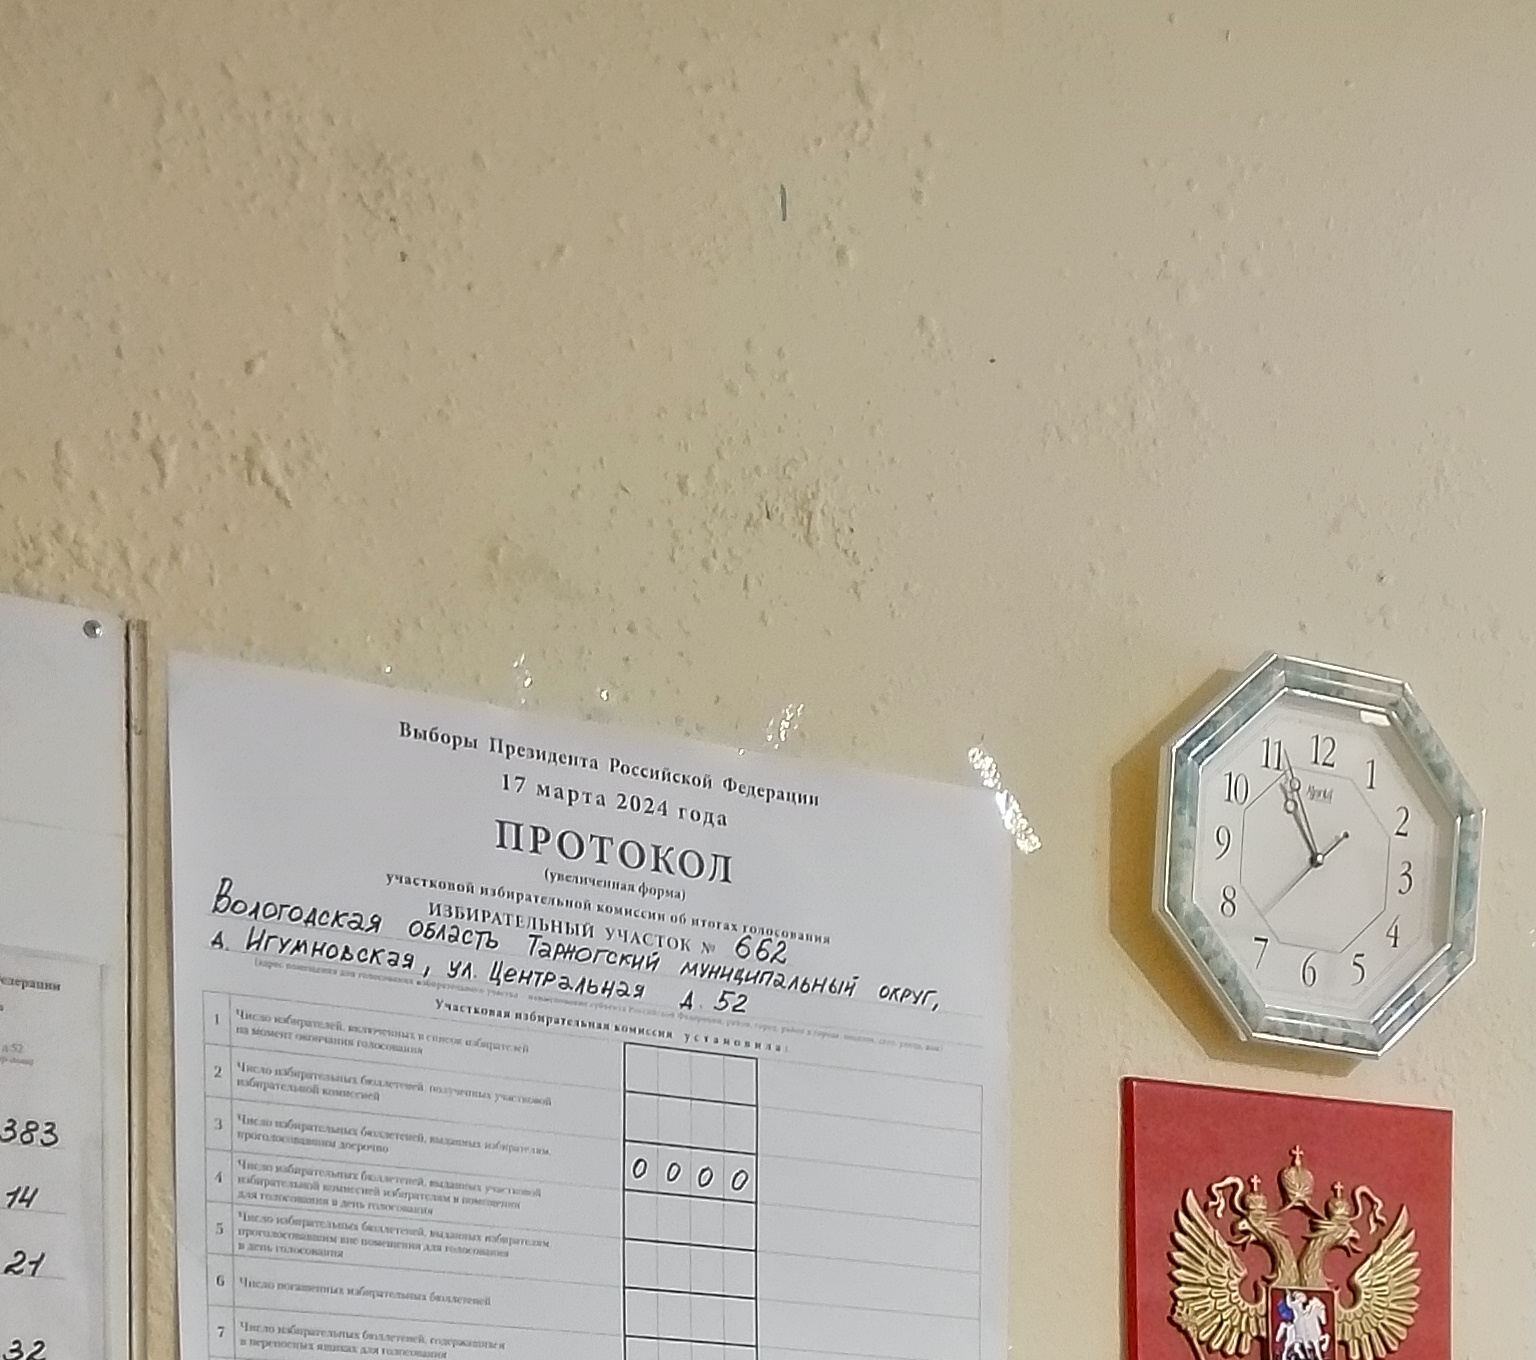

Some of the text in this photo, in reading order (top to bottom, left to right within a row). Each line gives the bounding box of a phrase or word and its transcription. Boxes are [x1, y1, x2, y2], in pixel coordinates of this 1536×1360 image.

[400, 721, 820, 807] Выборы Президента Российской Федерации
[1260, 736, 1285, 772] 11
[1310, 733, 1337, 769] 12
[1224, 771, 1250, 806] 10
[1365, 759, 1377, 791] 1
[502, 773, 728, 828] 17 марта 2024 года
[1394, 806, 1410, 838] 2
[494, 819, 734, 884] ПРОТОКОЛ
[1215, 825, 1232, 861] 9
[544, 866, 687, 903] (увеличенная форма)
[1397, 860, 1413, 896] 3
[385, 871, 832, 946] участковой избирательной комиссии об итогах голосования
[1220, 885, 1237, 918] 8
[428, 901, 717, 955] ИЗБИРАТЕЛЬНЫЙ УЧАСТОК №
[1385, 913, 1401, 949] 4
[734, 933, 789, 966] 662
[1253, 936, 1269, 970] 7
[1301, 950, 1318, 988] 6
[1350, 953, 1367, 987] 5
[713, 988, 750, 1014] 52
[213, 1012, 221, 1026] 1
[434, 998, 511, 1021] Участковая
[514, 1005, 611, 1031] избирательная
[613, 1022, 674, 1040] комиссия
[213, 1065, 223, 1079] 2
[0, 1116, 60, 1149] 383
[213, 1117, 223, 1131] 3
[214, 1170, 224, 1184] 4
[215, 1222, 225, 1236] 5
[3, 1248, 47, 1278] 21
[215, 1273, 226, 1288] 6
[216, 1326, 226, 1339] 7
